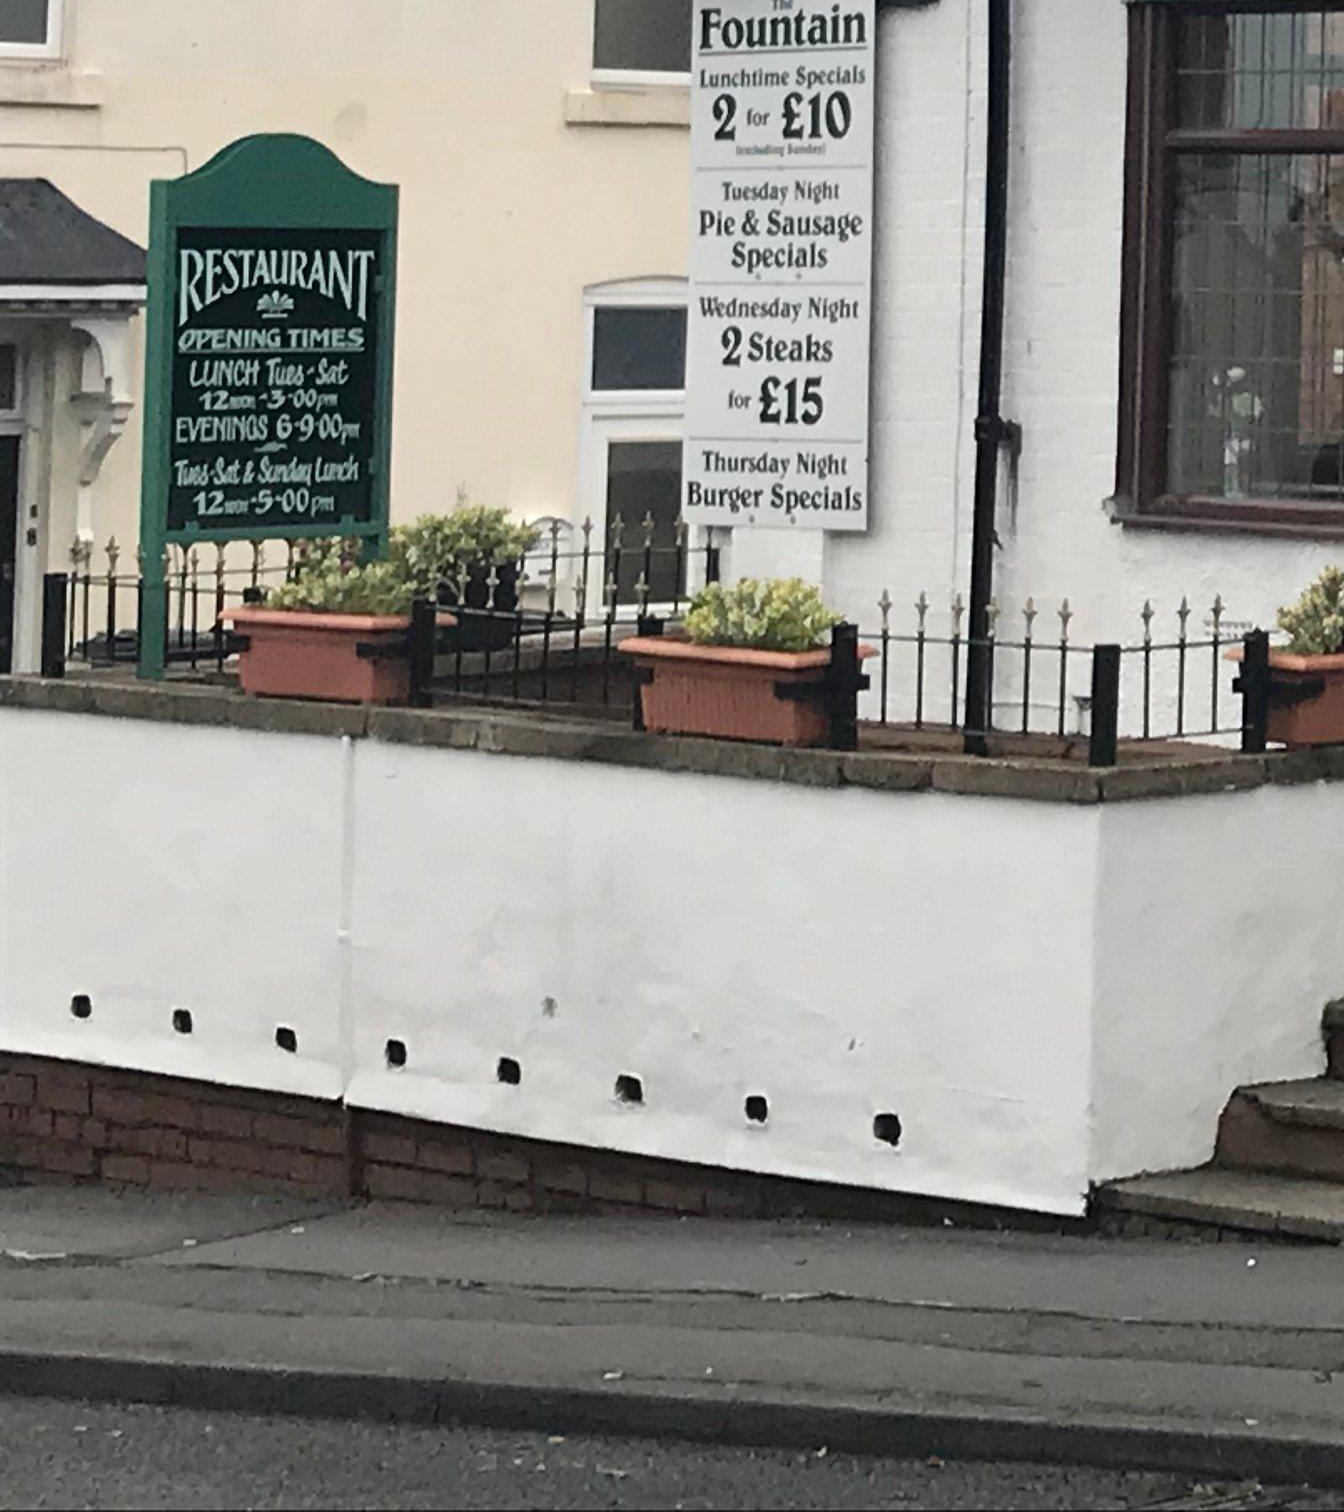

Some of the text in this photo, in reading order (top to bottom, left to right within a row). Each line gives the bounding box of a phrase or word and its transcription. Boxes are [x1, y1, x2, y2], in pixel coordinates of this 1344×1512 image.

[699, 4, 866, 50] Fountain
[700, 65, 866, 90] Lunchtime Specials
[712, 90, 852, 141] 2 for £10
[721, 180, 840, 206] Tuesday Night
[699, 208, 863, 242] Pie & Sausage
[731, 241, 828, 273] Specials
[178, 249, 376, 327] RESTAURANT
[699, 296, 860, 324] Wednesday Night
[178, 327, 365, 350] OPENING TIMES
[721, 325, 834, 368] 2 Steaks
[189, 358, 261, 388] LUNCH
[727, 375, 824, 426] for £15
[175, 414, 270, 443] EVENINGS
[242, 459, 256, 485] &
[258, 454, 312, 487] Sunday
[315, 453, 360, 483] Lunch
[702, 450, 848, 480] Thursday Night
[686, 481, 863, 514] Burger Specials
